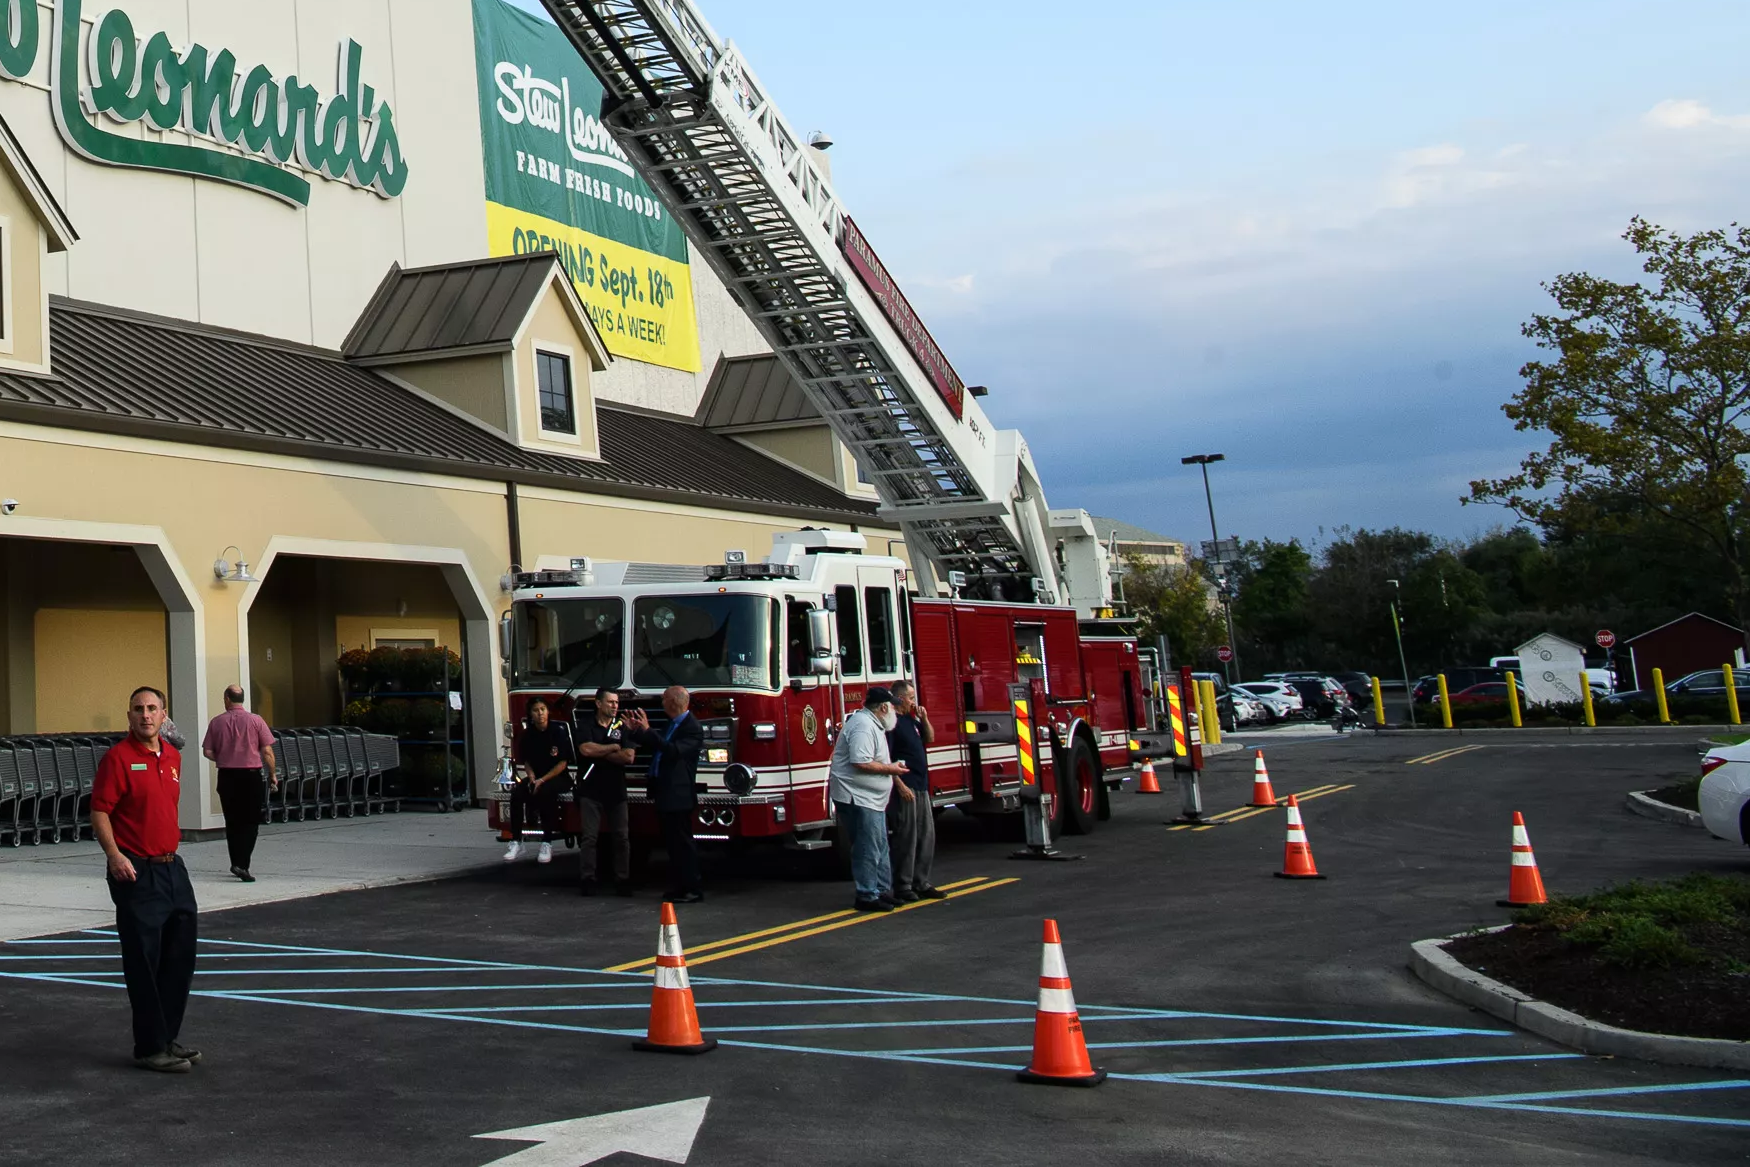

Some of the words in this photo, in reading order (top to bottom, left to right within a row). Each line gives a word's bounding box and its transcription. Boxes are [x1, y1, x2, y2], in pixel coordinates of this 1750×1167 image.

[494, 61, 562, 134] Stew
[516, 150, 561, 185] FARM
[565, 168, 612, 203] FRESH
[616, 187, 661, 221] FOODS
[599, 253, 644, 309] Sept.
[648, 266, 674, 309] 18th
[617, 312, 625, 335] A
[628, 315, 666, 346] WEEK!
[848, 222, 890, 291] PARAMUS
[891, 284, 910, 321] FIRE
[911, 316, 964, 403] DEPARTMENT
[890, 302, 919, 353] TRUCK
[1597, 635, 1613, 643] STOP
